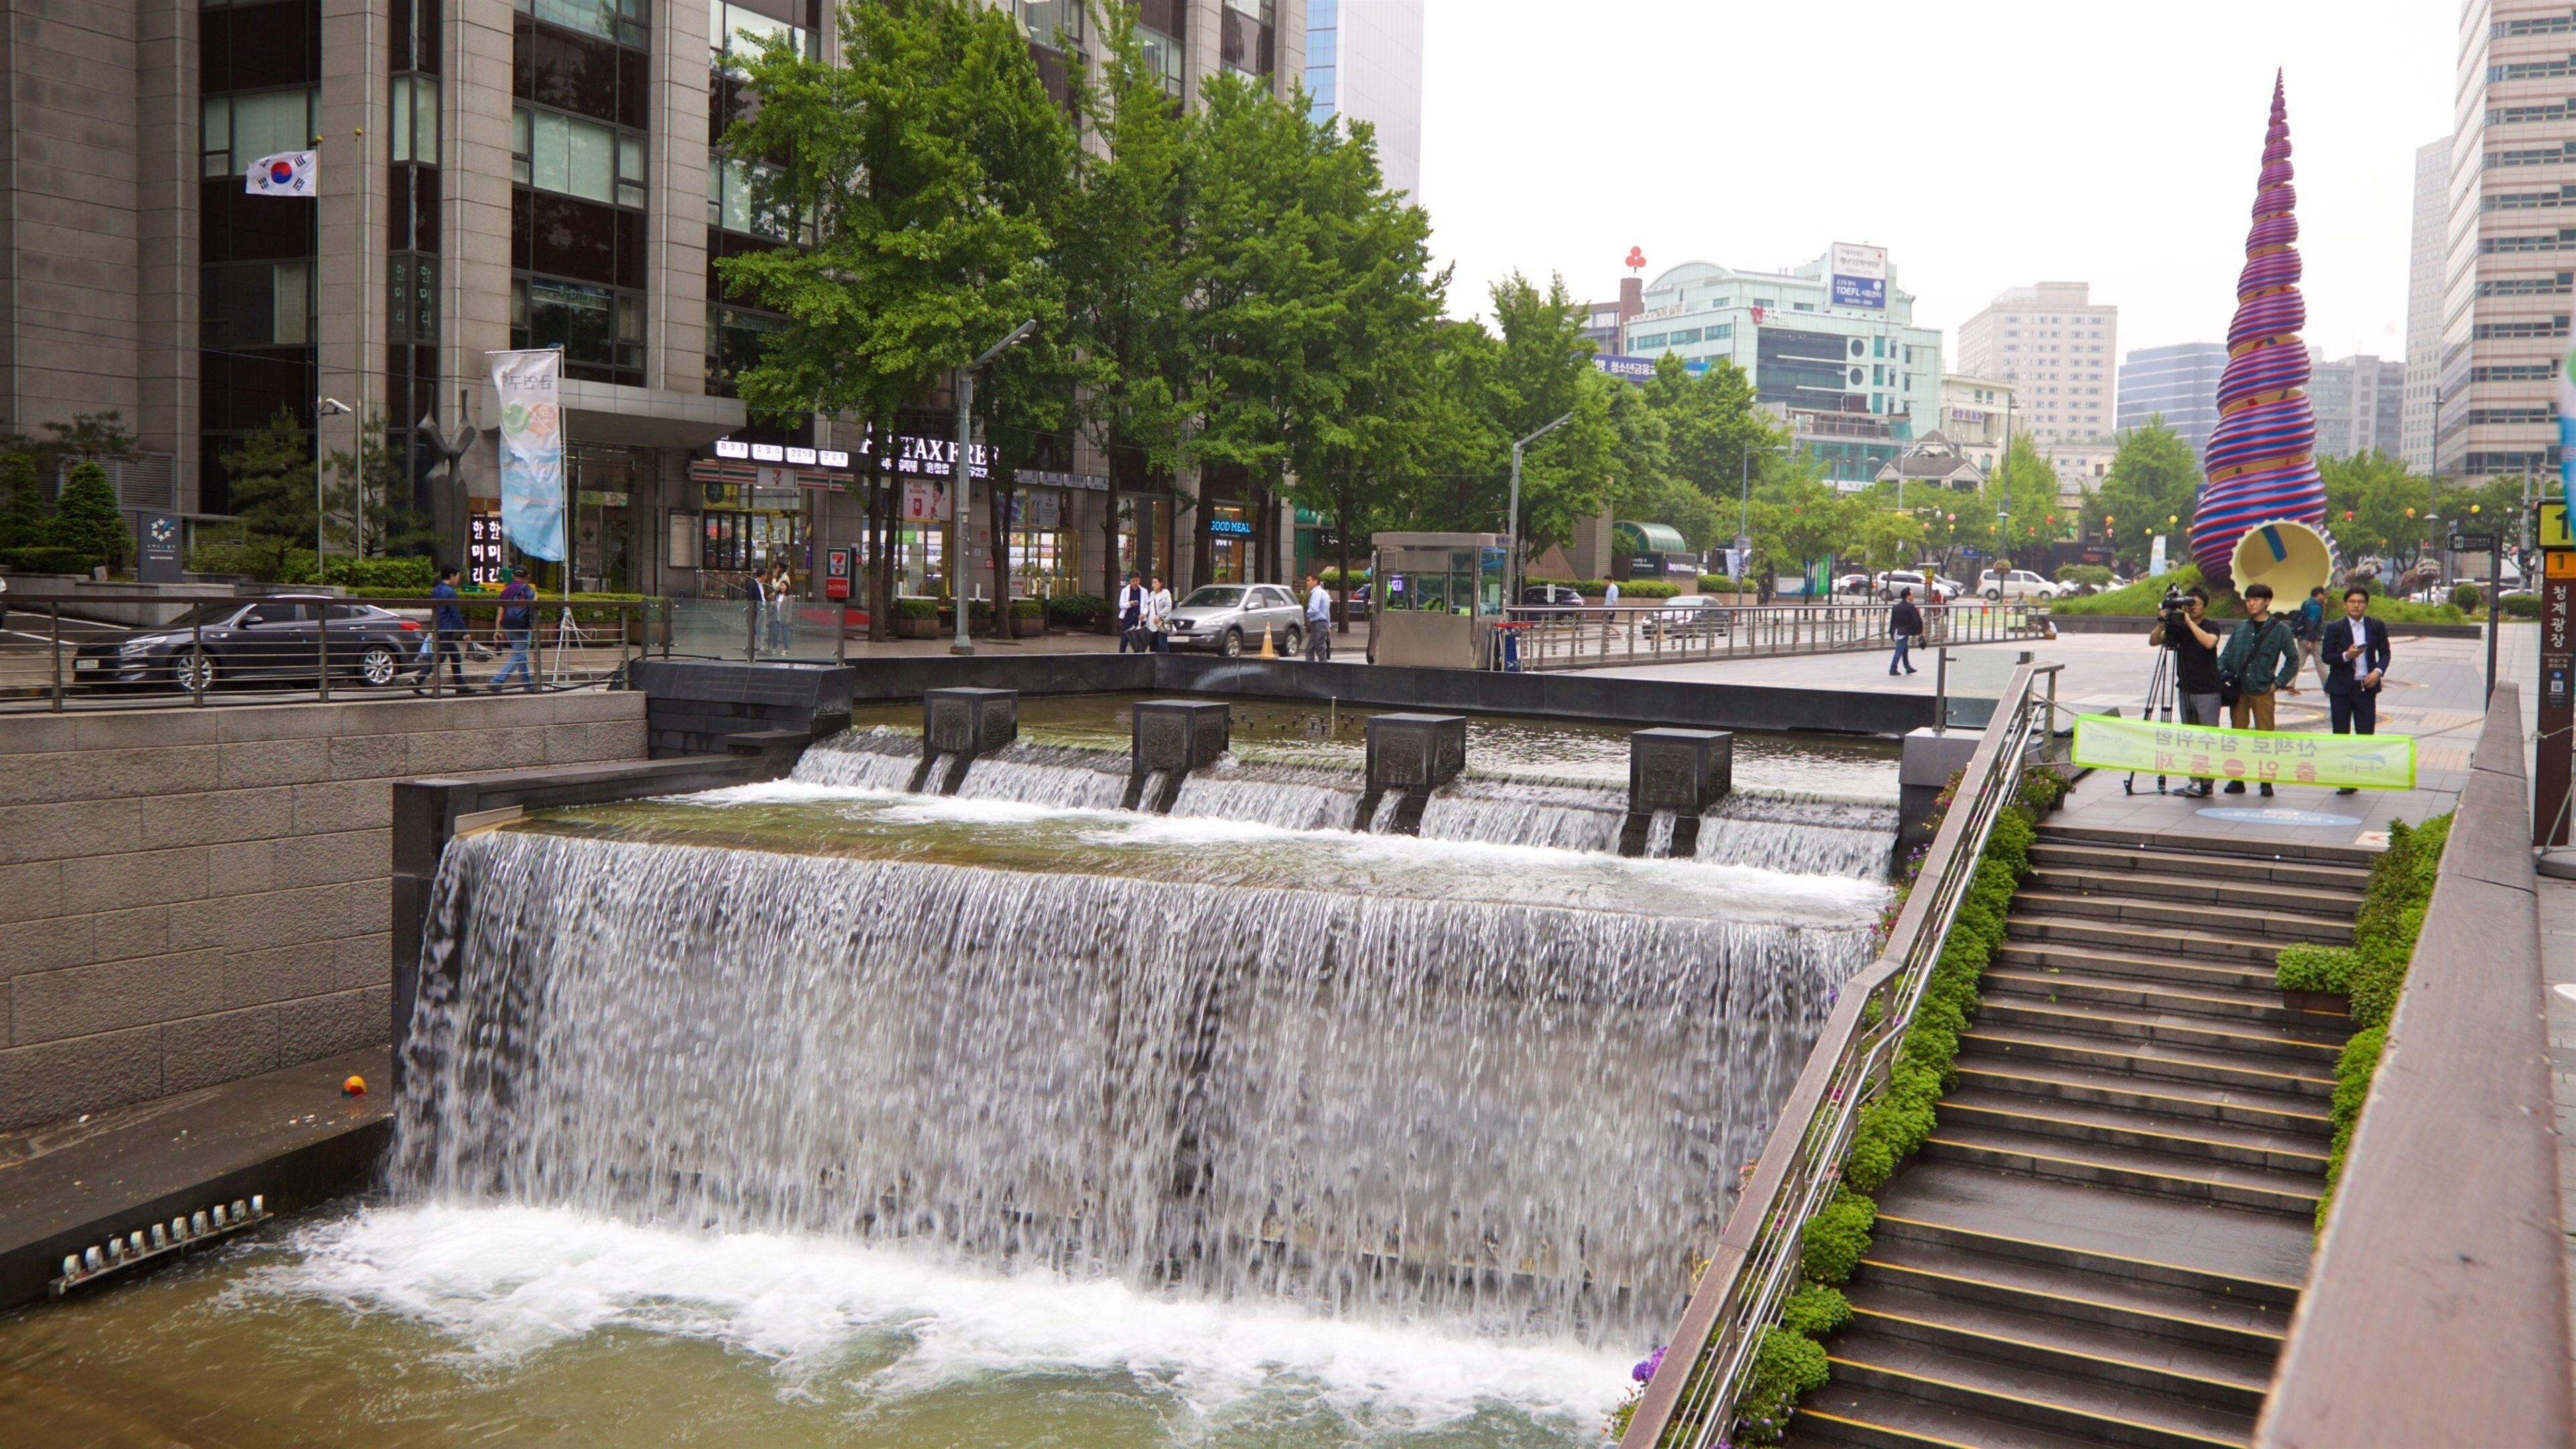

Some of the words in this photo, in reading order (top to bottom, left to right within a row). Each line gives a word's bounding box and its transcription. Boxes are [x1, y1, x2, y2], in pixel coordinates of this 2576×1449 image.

[394, 263, 406, 325] 한미리
[419, 265, 431, 328] 한미리
[1836, 286, 1860, 297] TOEFL
[899, 435, 944, 462] TAX
[1231, 522, 1250, 533] MEAL
[2555, 510, 2569, 540] 1
[472, 521, 484, 585] 한미리
[2555, 554, 2565, 570] 1
[2550, 586, 2567, 648] 청계광장
